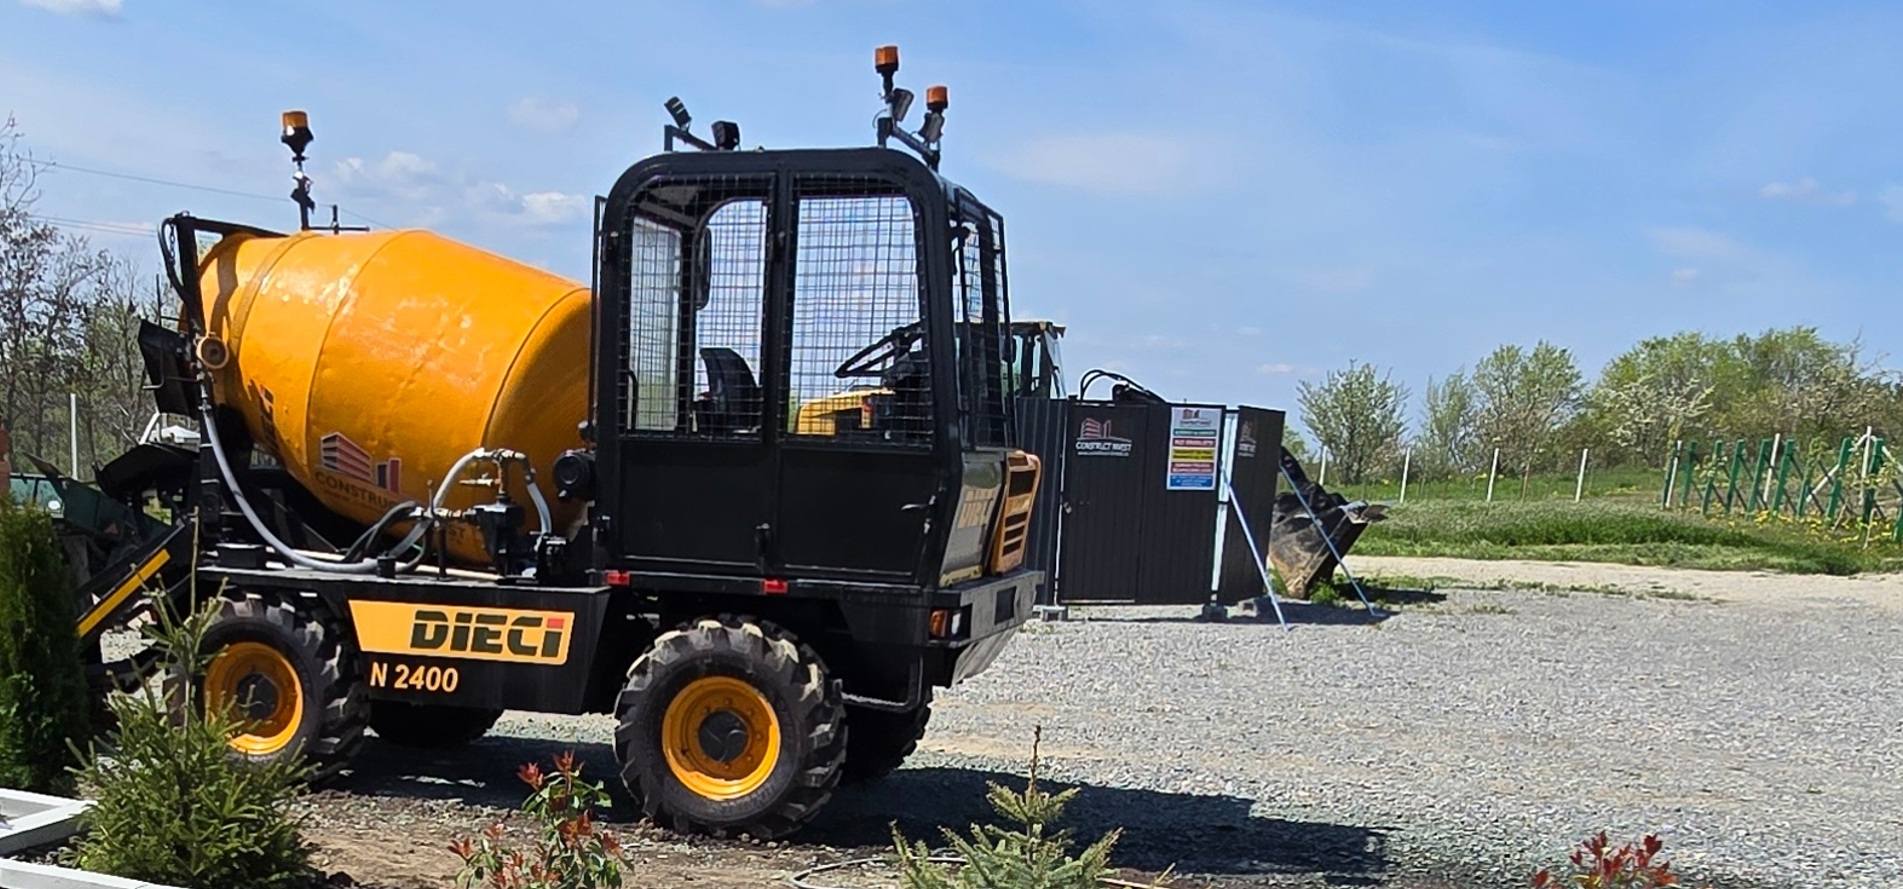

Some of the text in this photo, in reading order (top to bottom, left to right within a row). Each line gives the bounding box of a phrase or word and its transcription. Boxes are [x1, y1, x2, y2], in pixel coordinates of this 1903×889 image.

[314, 471, 398, 508] CONSTRU
[370, 662, 459, 692] N 2400
